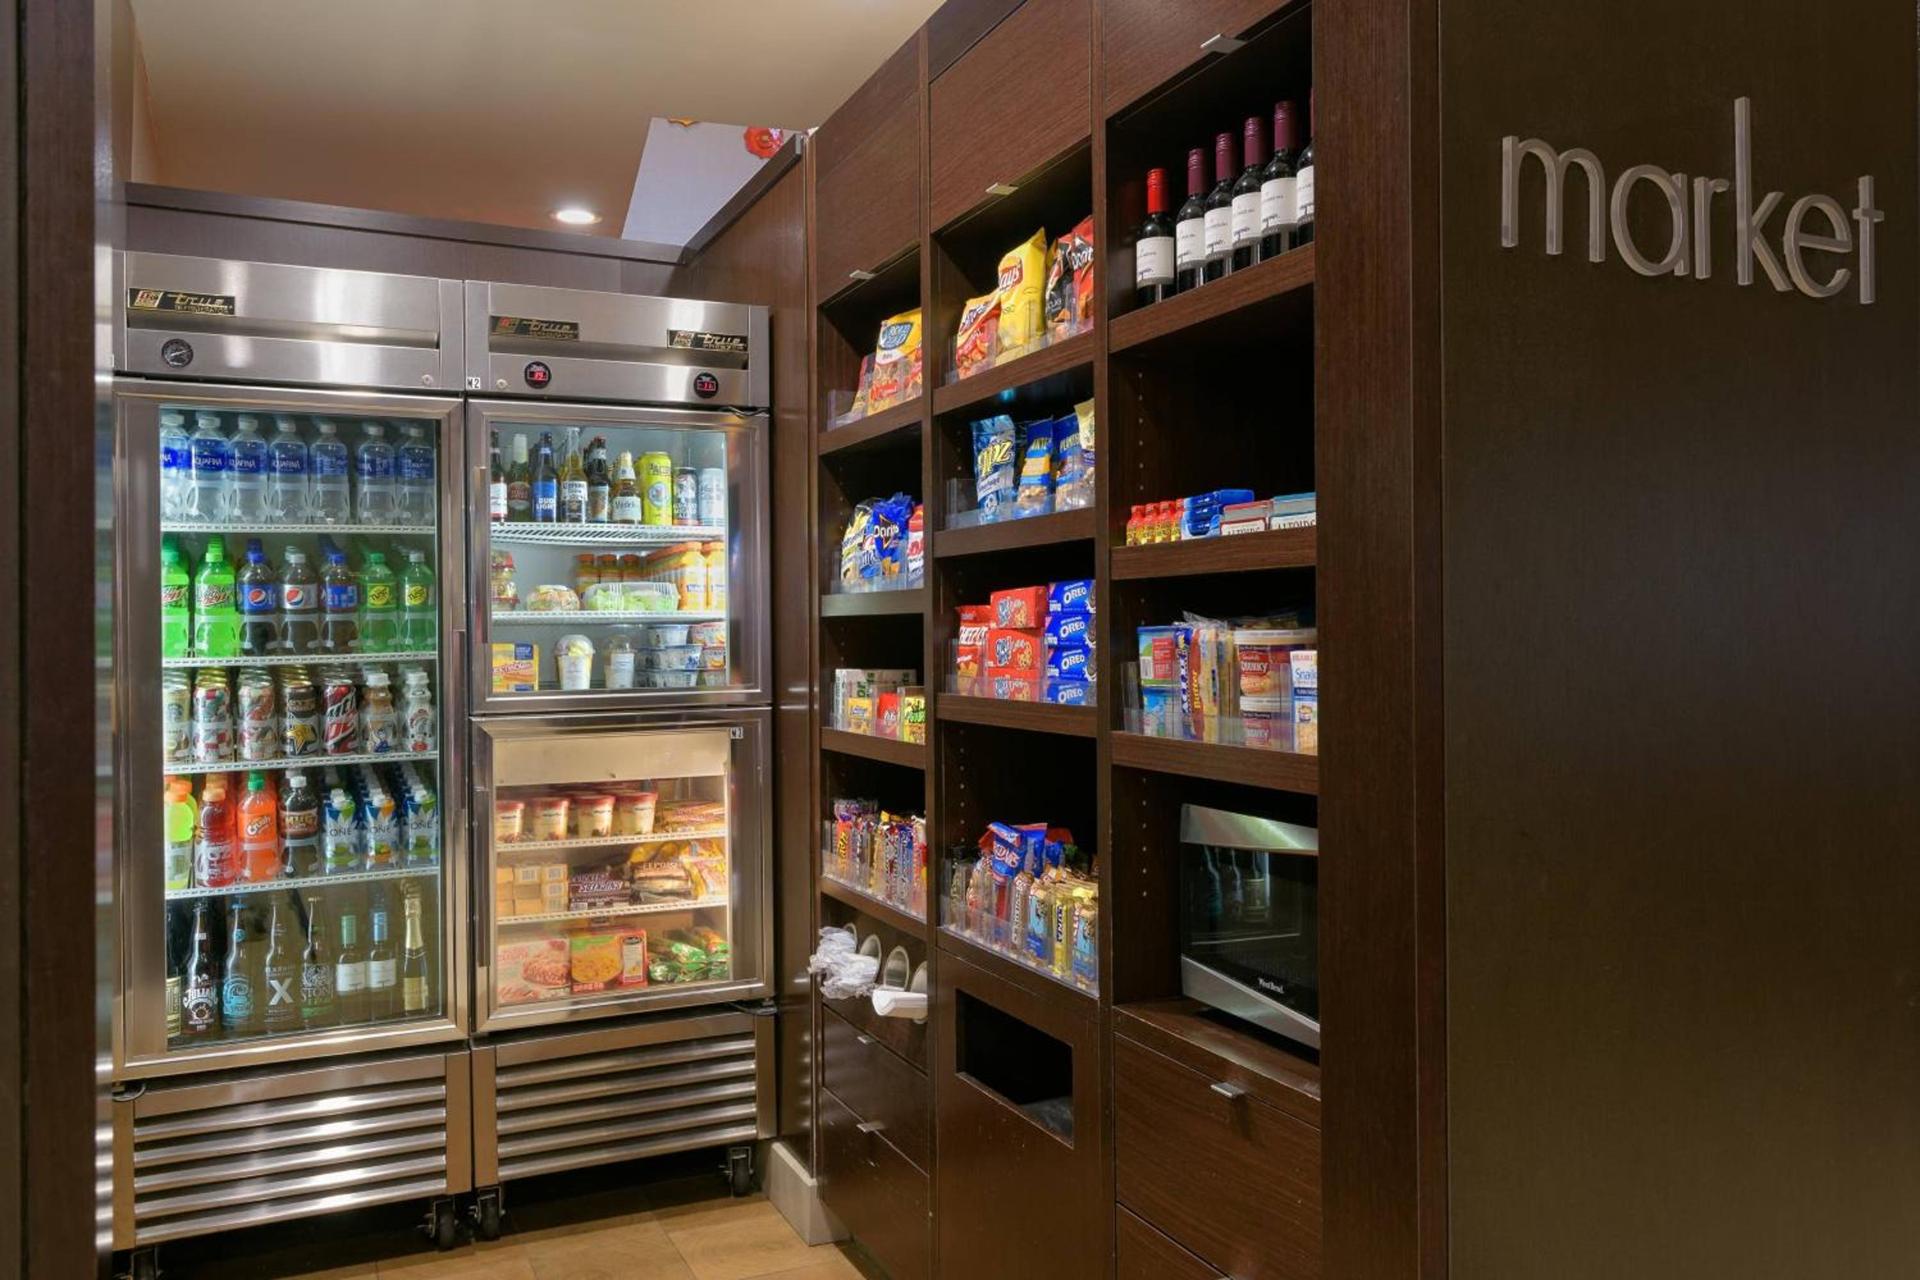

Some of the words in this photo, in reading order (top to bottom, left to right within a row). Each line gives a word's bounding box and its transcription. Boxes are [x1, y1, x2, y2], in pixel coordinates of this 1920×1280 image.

[1501, 96, 1885, 305] market
[1063, 583, 1087, 604] OREO
[1060, 621, 1085, 638] OREO
[1061, 655, 1085, 670] OREO
[1058, 688, 1084, 703] OREO
